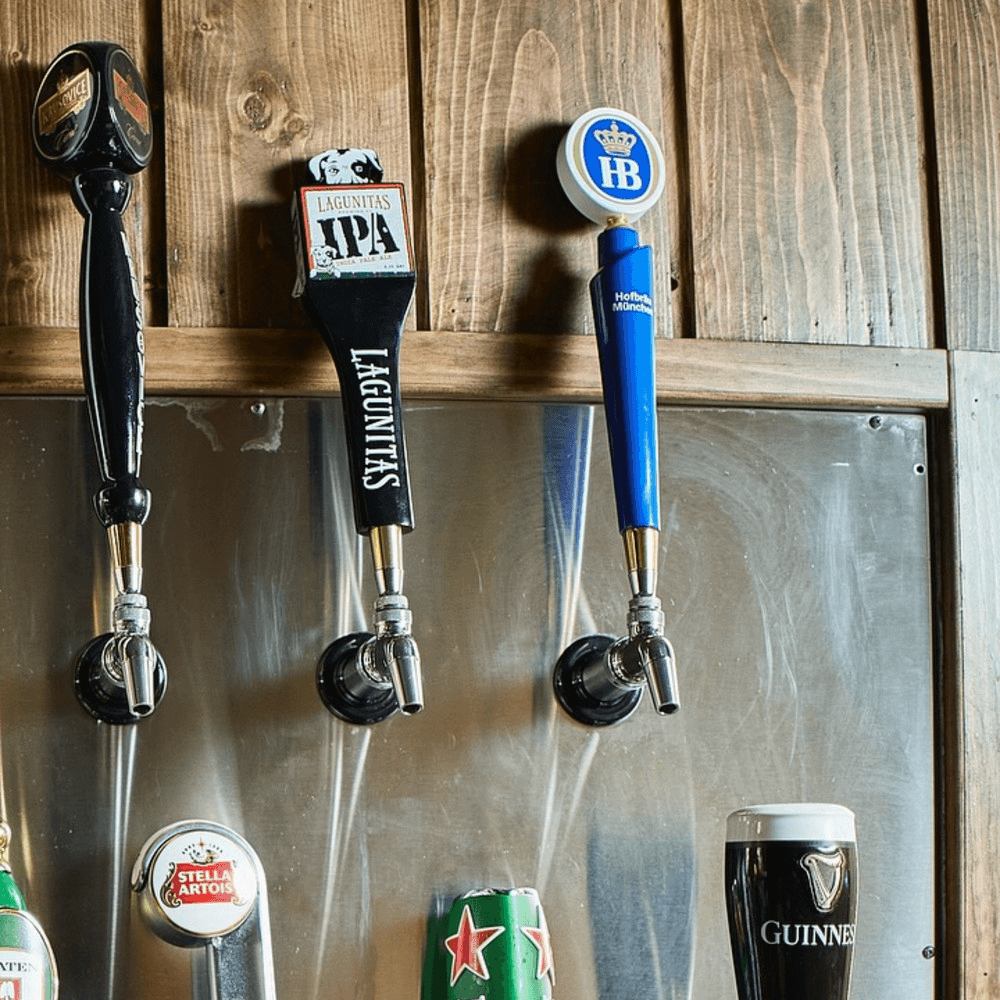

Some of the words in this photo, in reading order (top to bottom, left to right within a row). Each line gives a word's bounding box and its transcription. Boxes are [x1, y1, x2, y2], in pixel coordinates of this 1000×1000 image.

[598, 155, 643, 191] HB
[317, 194, 391, 213] LAGUNITAS
[316, 212, 401, 260] IPA
[349, 348, 401, 491] LAGUNITAS
[177, 870, 232, 883] STELLA
[178, 882, 234, 896] ARTOIS
